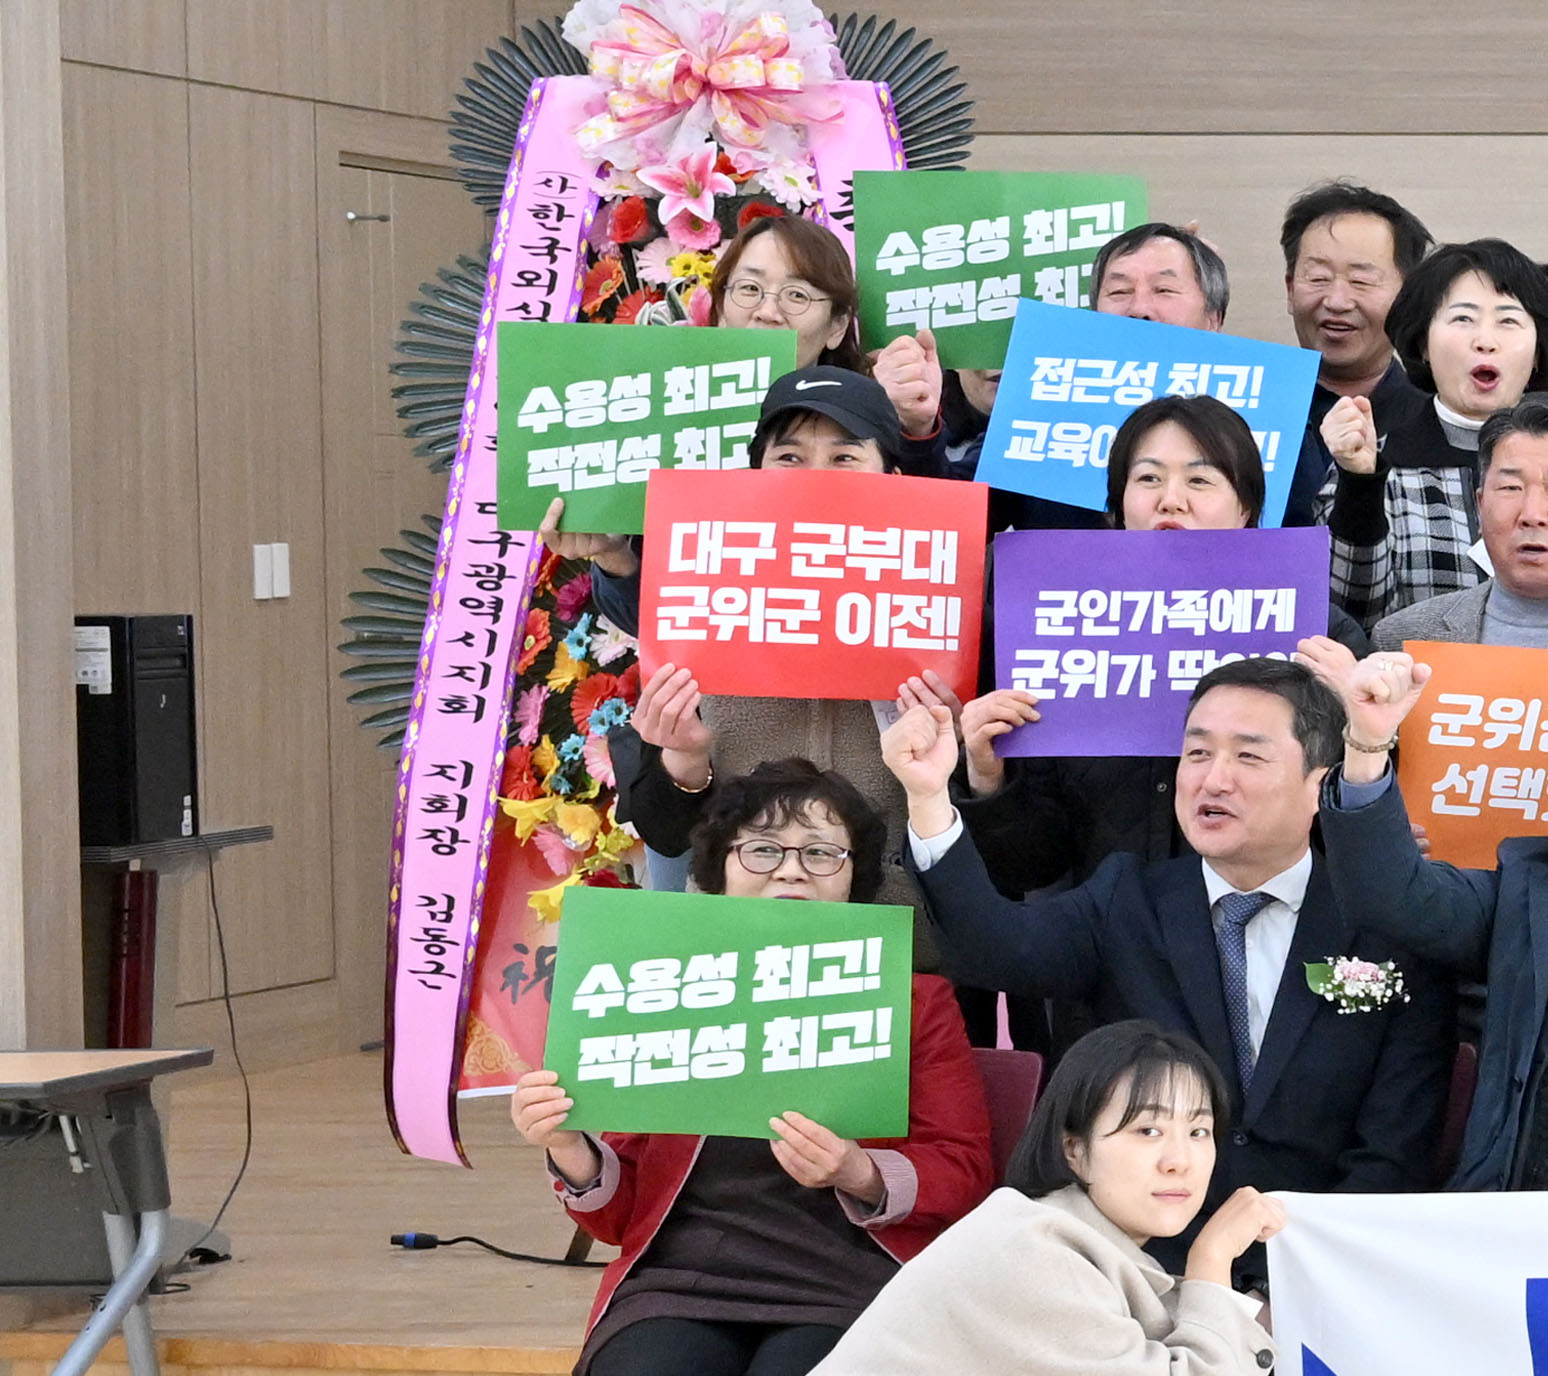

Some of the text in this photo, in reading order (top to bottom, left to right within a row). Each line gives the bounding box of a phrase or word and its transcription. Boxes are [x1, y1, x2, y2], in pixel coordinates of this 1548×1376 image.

[876, 201, 1125, 276] 수용성 최고!
[886, 274, 1021, 331] 작전성
[518, 356, 771, 434] 수용성 최고!
[1030, 356, 1159, 406] 접근성
[528, 421, 758, 492] 작전성 최고
[668, 520, 959, 585] 대구 군부대
[656, 586, 962, 652] 군위군 이전!
[1035, 588, 1297, 637] 군인가족에게
[1011, 648, 1157, 700] 군위가
[416, 760, 473, 856] 지회장
[407, 894, 462, 991] 김동근
[572, 937, 883, 1019] 수용성 최고!
[577, 1007, 893, 1088] 작전성 최고!
